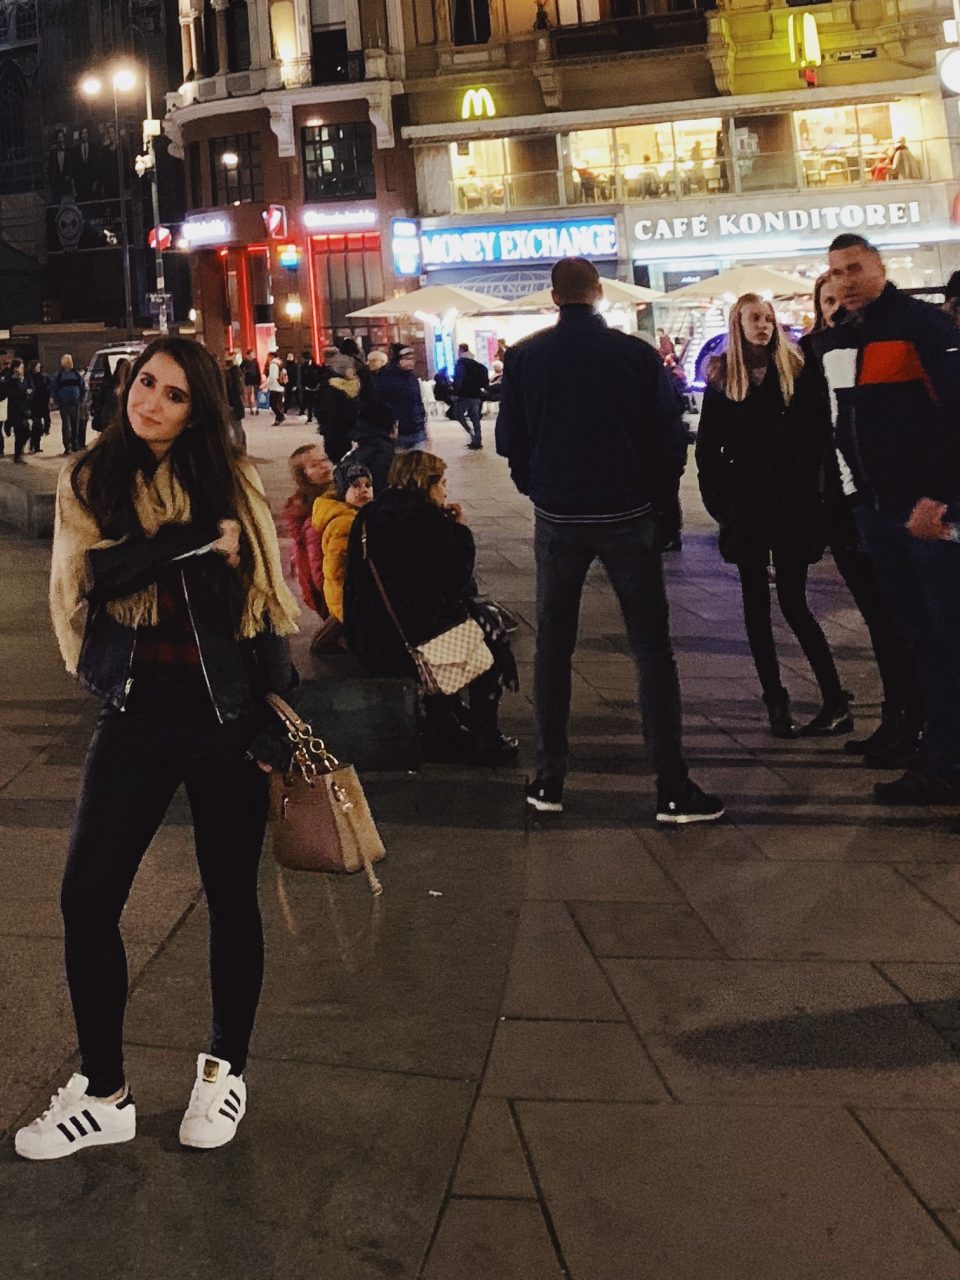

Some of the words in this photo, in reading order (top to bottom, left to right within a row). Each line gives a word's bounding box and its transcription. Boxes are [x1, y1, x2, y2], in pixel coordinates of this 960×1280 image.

[634, 214, 709, 241] CAFÉ
[719, 202, 921, 236] KONDITOREI
[421, 231, 497, 264] MONEY
[500, 224, 618, 260] EXCHANGE
